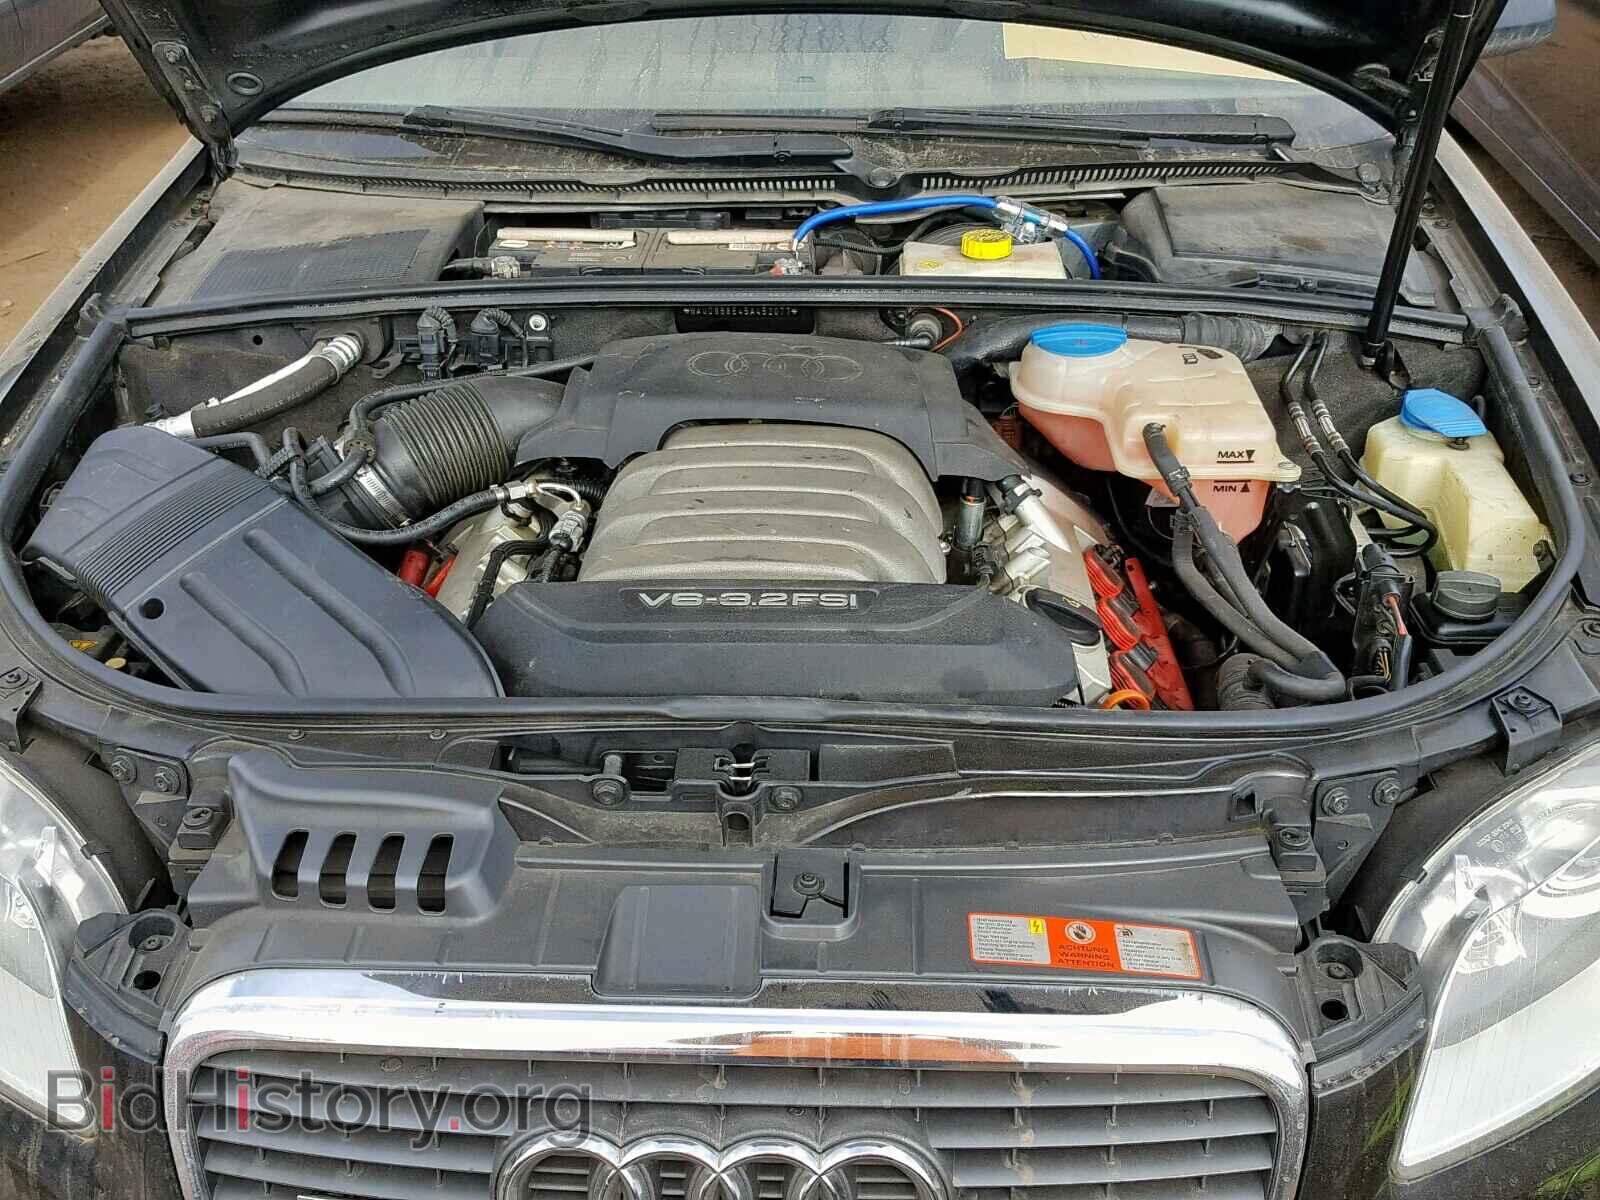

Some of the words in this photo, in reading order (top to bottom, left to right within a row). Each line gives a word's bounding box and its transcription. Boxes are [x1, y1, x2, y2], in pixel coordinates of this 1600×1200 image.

[1217, 450, 1245, 459] MAX
[1213, 485, 1237, 493] MIN
[638, 592, 857, 608] V6-3.2FSI
[1057, 944, 1109, 953] ACHTUNG
[1057, 951, 1111, 960] WARNING
[1057, 958, 1115, 968] ATTENTION
